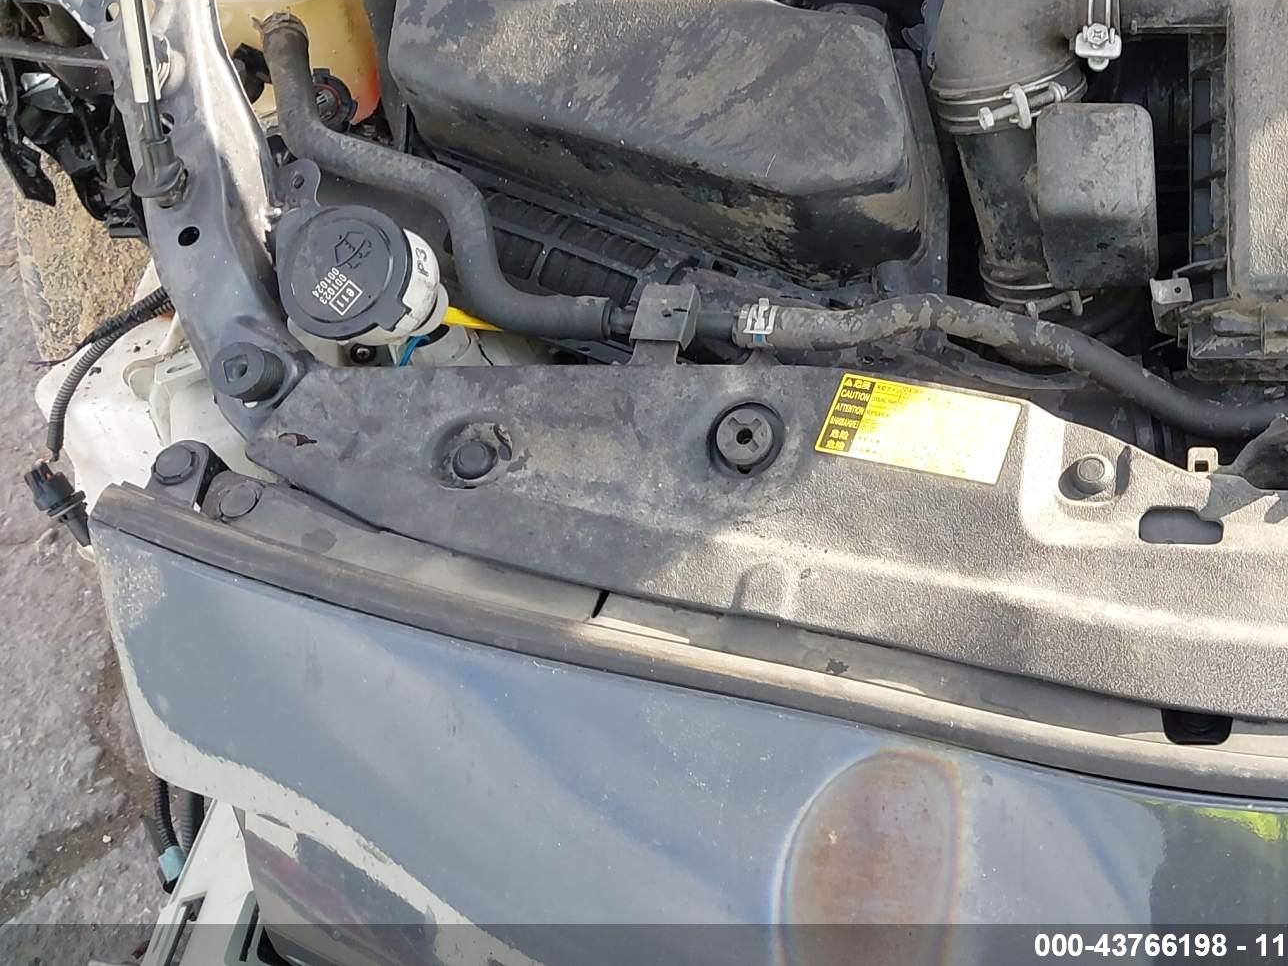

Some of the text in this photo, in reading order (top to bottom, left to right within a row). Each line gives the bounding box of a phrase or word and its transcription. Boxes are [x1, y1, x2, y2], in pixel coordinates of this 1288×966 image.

[311, 267, 339, 298] 001024
[319, 273, 347, 304] 001023
[335, 287, 355, 308] e11
[840, 389, 870, 402] CAUTION
[835, 402, 865, 415] ATTENTION
